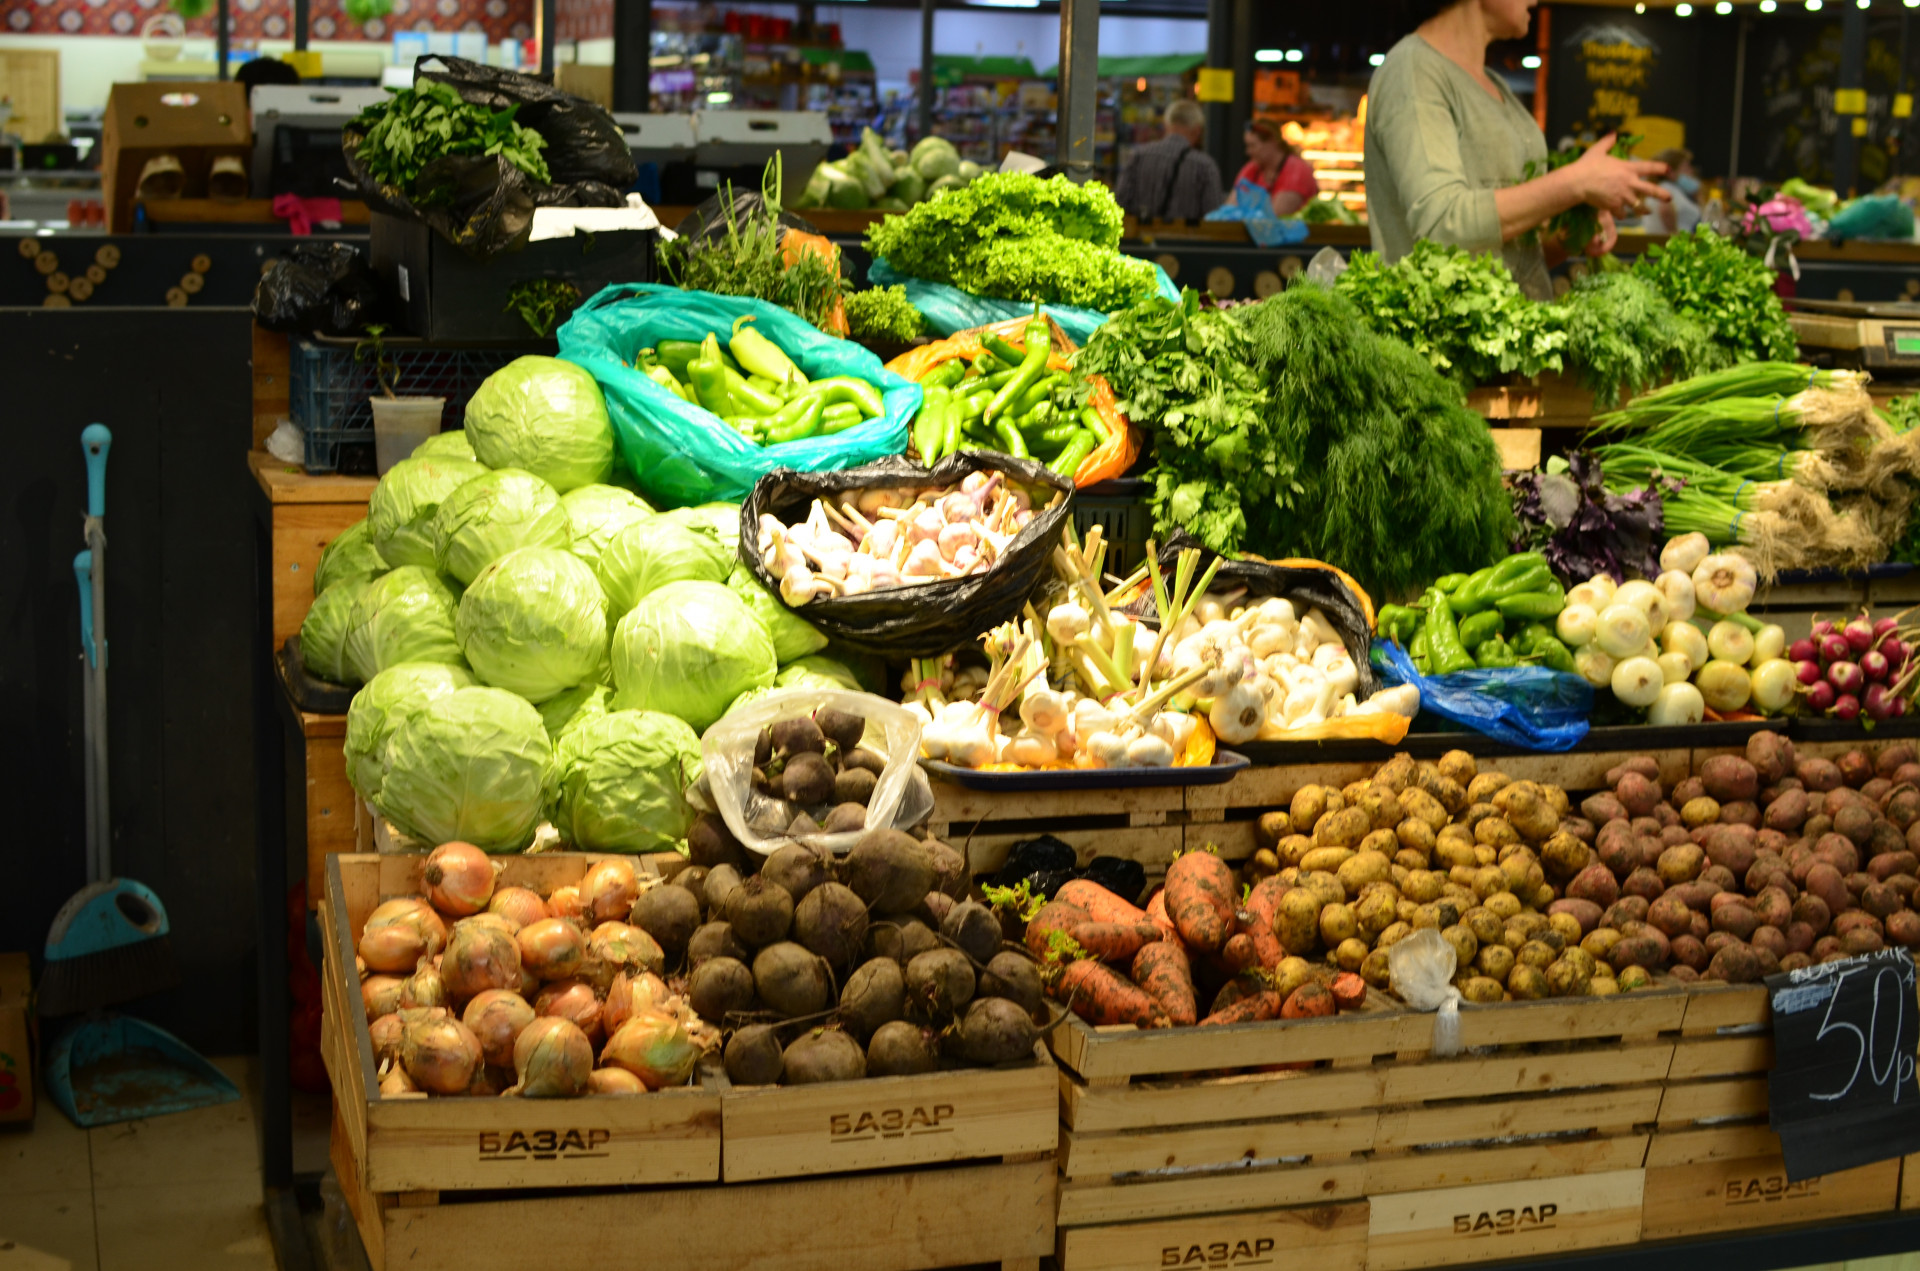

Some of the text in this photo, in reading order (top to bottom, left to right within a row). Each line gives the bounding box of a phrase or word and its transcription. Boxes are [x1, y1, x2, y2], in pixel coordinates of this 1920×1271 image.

[830, 1103, 955, 1135] БАЗАР
[479, 1128, 610, 1153] БАЗАР
[1453, 1203, 1558, 1234] БАЗАР
[1161, 1237, 1275, 1266] БАЗАР
